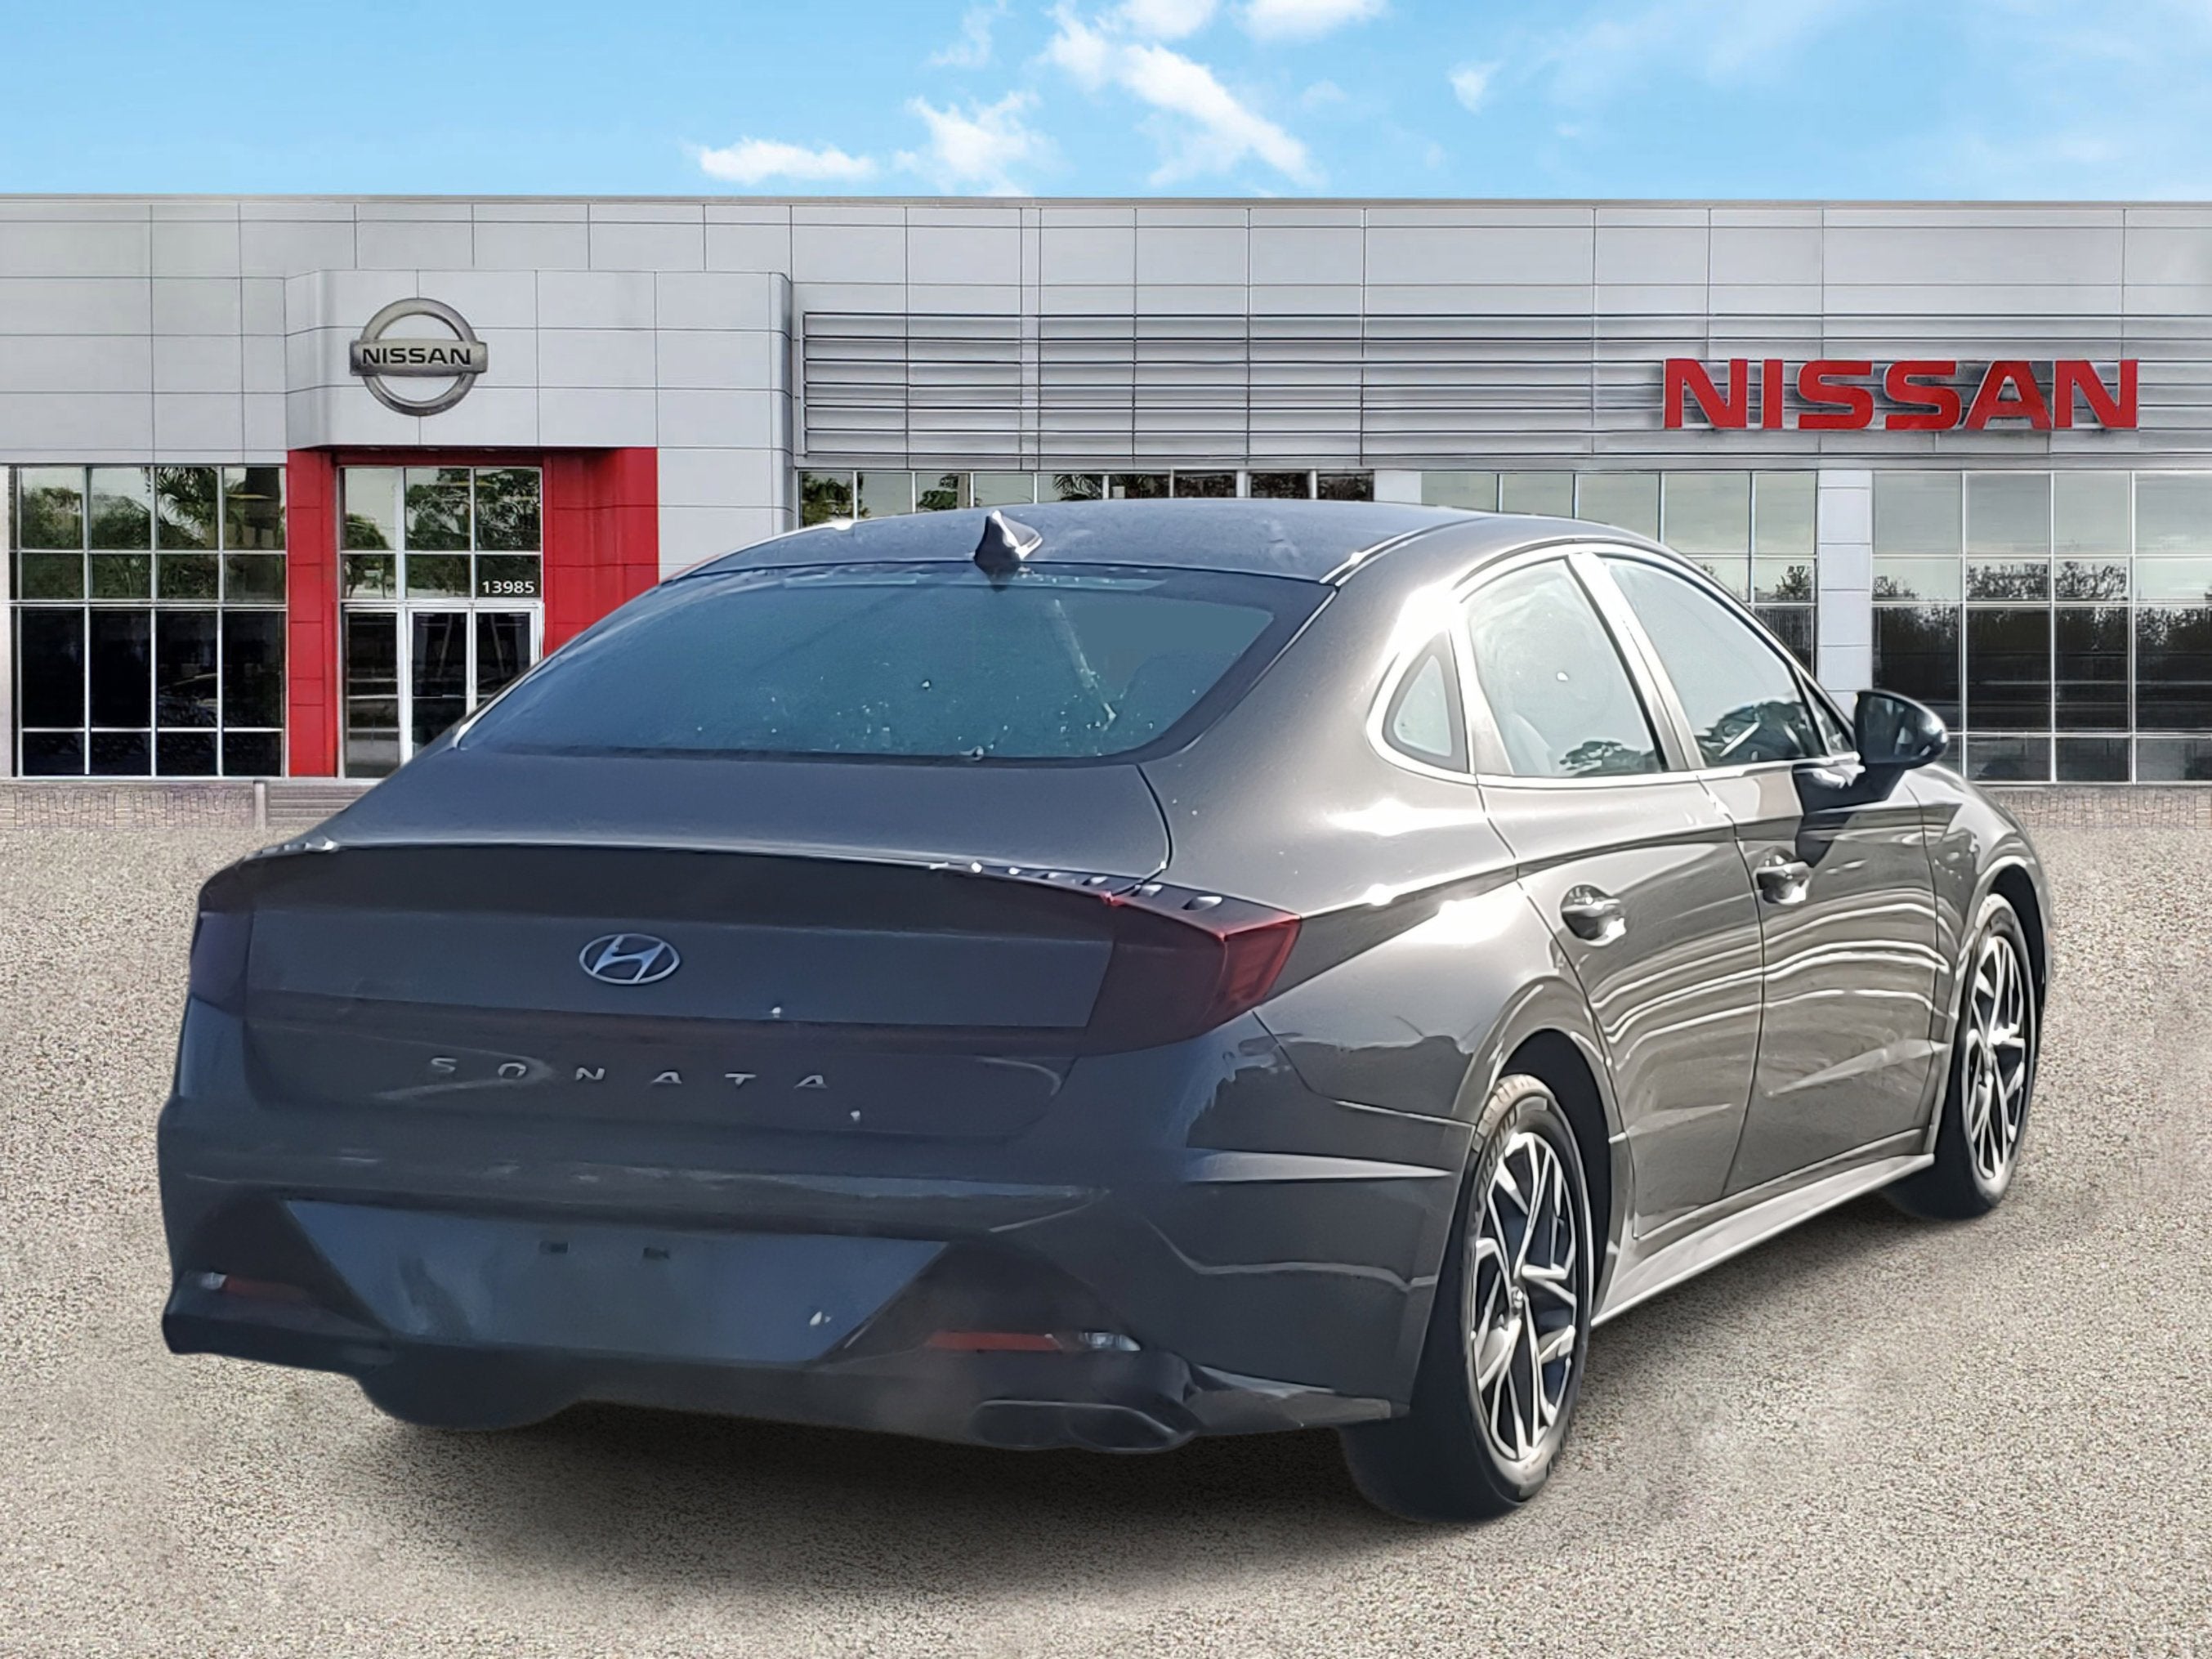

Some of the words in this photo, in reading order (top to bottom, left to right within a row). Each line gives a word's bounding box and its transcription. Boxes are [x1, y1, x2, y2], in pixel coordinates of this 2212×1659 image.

[363, 347, 471, 365] NISSAN
[1664, 358, 2138, 430] NISSAN
[482, 581, 534, 594] 13985
[430, 1056, 827, 1089] SONATA
